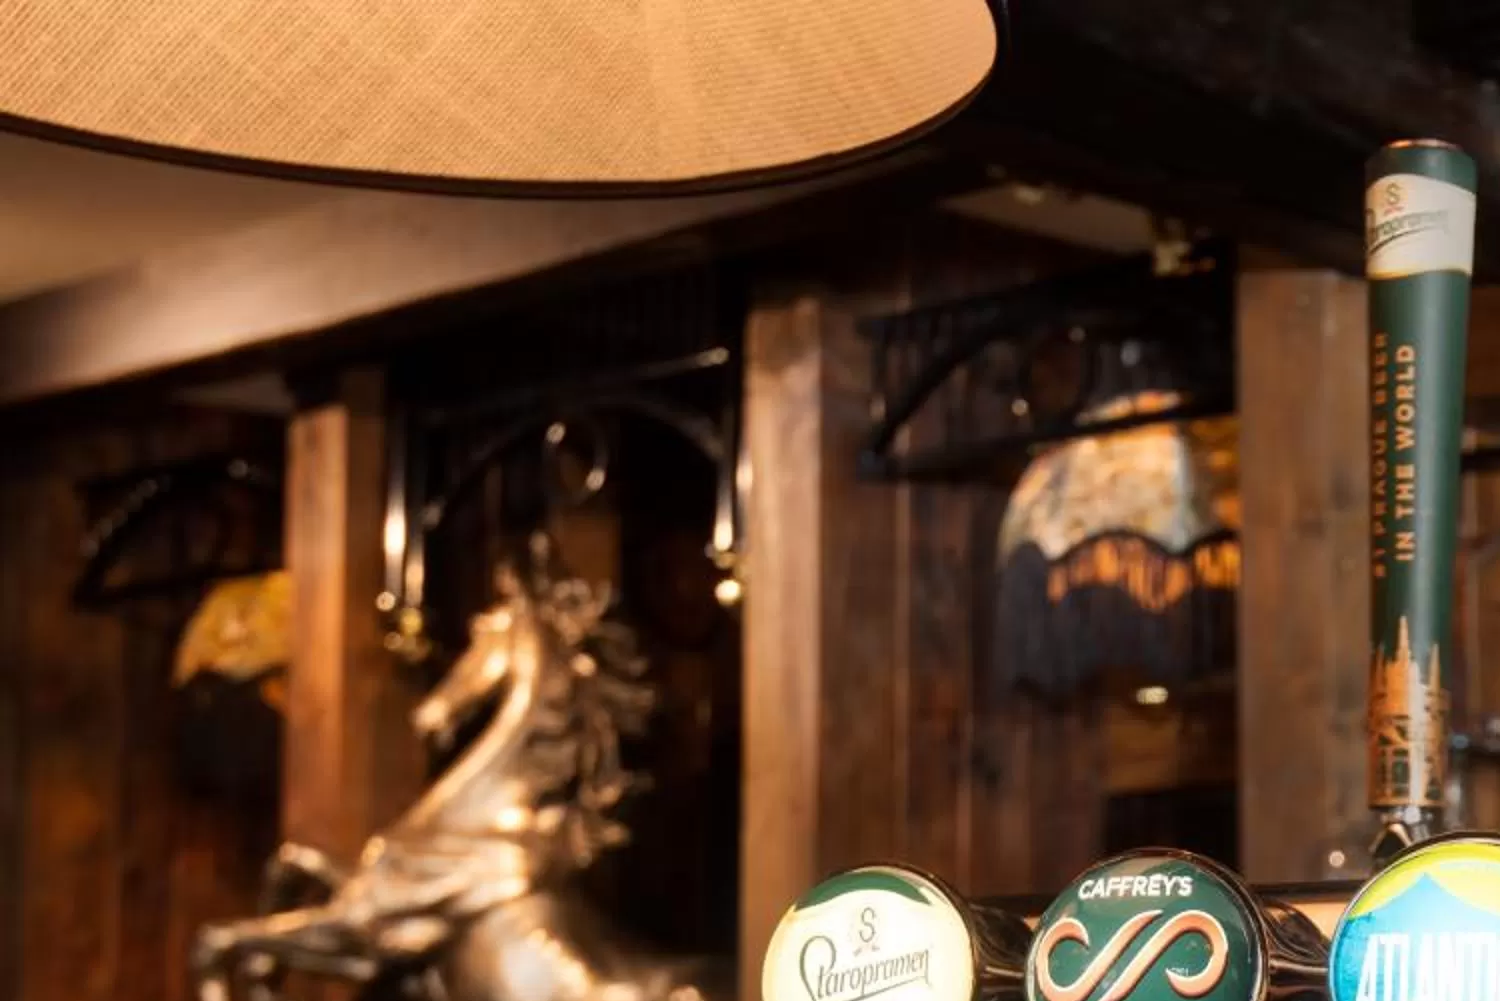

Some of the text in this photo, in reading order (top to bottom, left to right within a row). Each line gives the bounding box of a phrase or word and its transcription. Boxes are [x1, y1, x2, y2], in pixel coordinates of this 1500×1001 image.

[1374, 333, 1388, 405] BEER
[1373, 420, 1388, 533] PRAGUE
[1395, 344, 1416, 561] IN THE WORLD
[1078, 873, 1194, 899] CAFFREY'S
